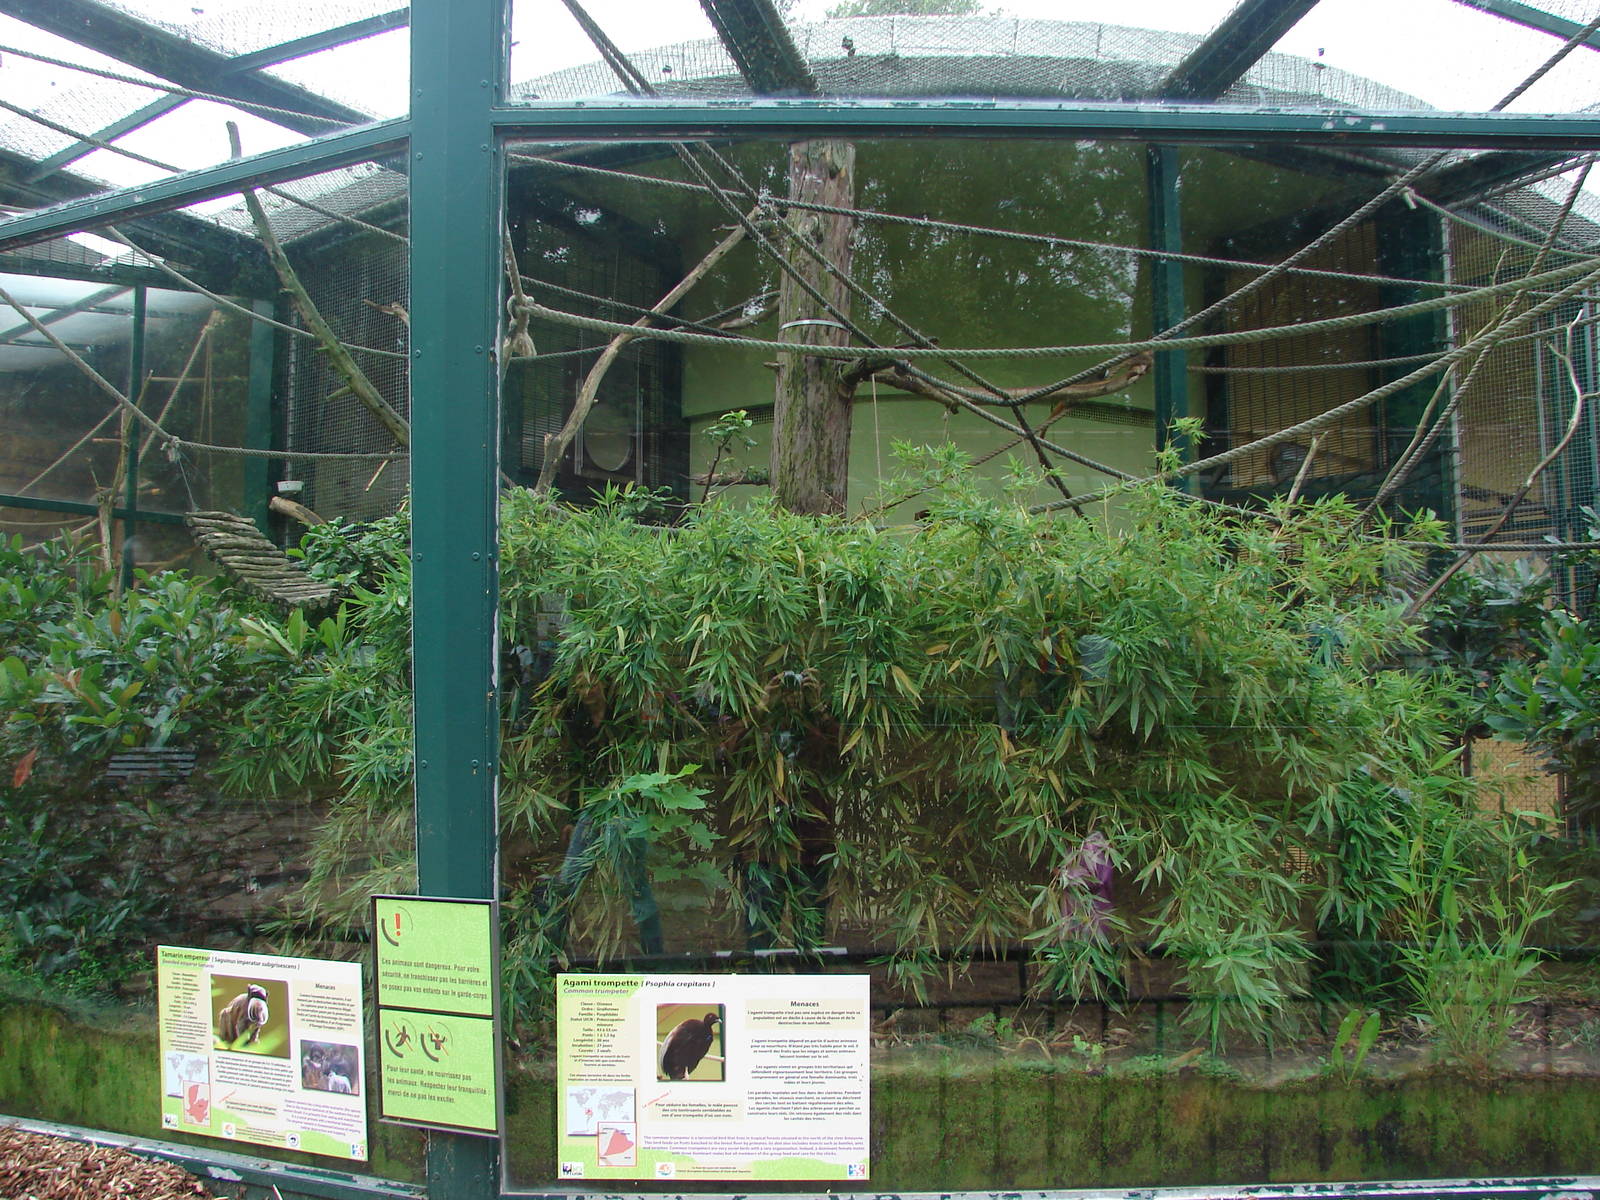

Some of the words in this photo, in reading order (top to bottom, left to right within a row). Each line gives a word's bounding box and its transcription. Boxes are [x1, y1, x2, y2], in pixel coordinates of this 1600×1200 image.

[454, 964, 466, 972] Pour
[563, 979, 592, 988] Agami
[593, 980, 639, 988] trompette
